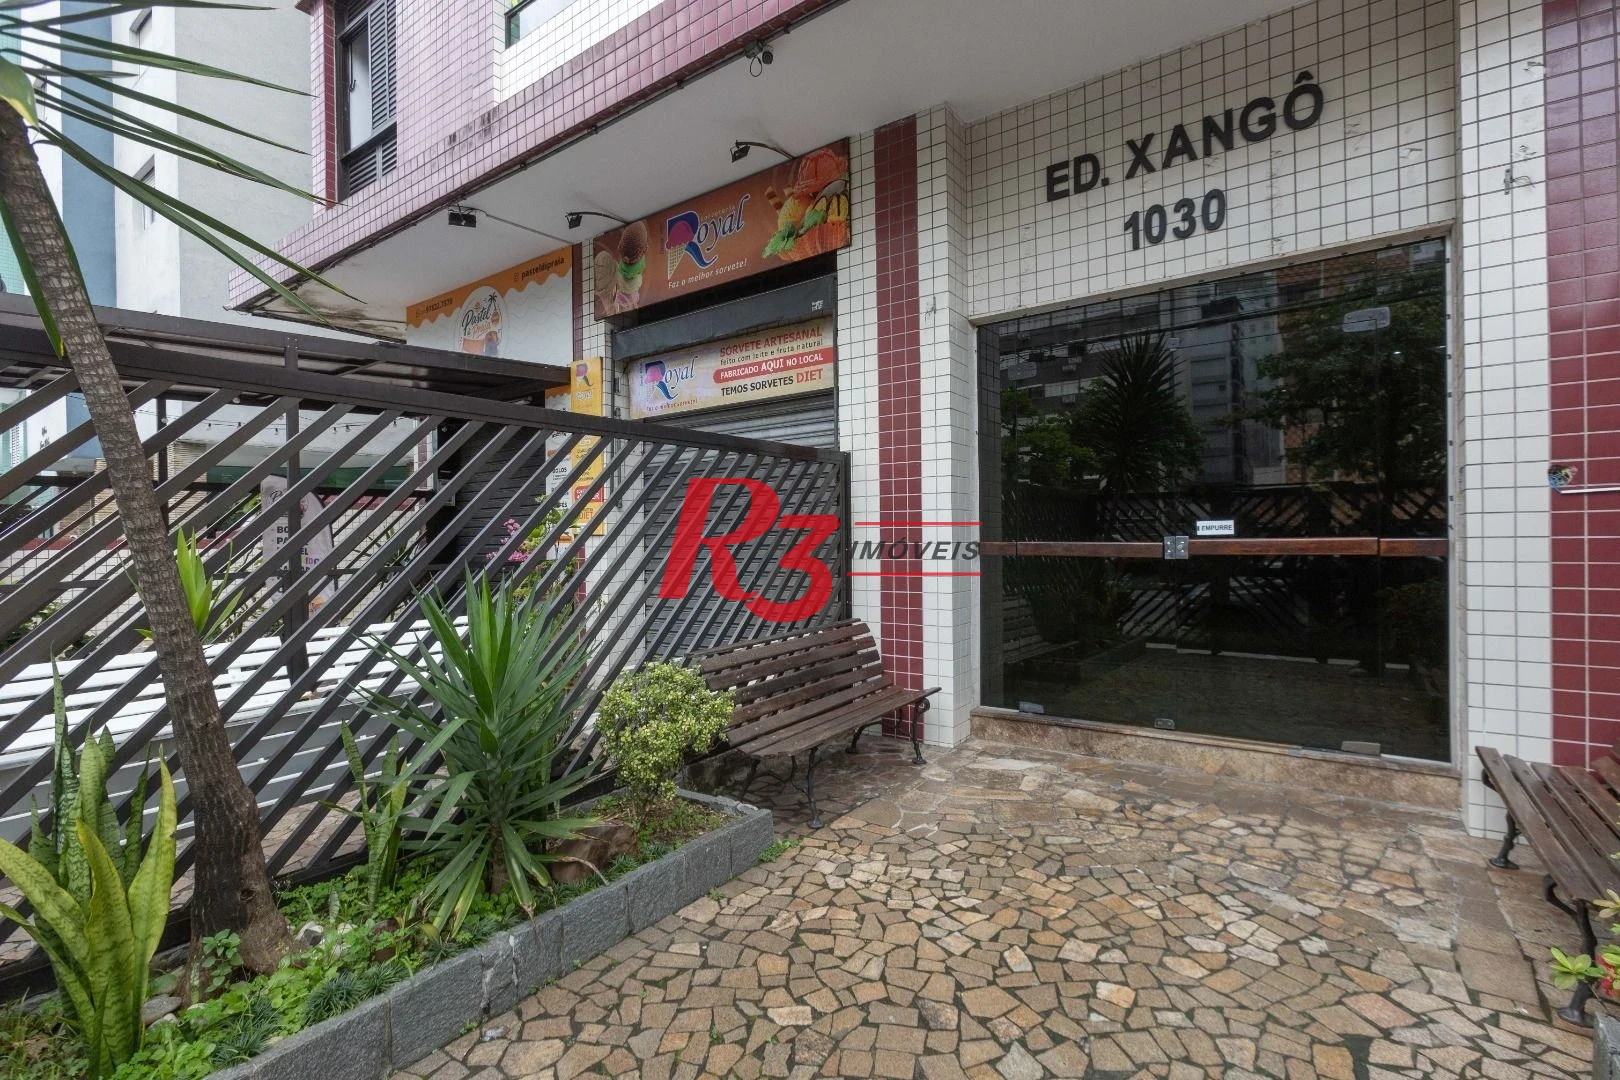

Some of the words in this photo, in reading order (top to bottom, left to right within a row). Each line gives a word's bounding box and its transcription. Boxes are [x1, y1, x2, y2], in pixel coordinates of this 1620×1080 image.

[1046, 153, 1110, 202] ED.
[1125, 70, 1324, 180] XANGÔ
[665, 194, 750, 270] Royal
[1123, 188, 1226, 251] 1030
[687, 270, 713, 284] melhor
[715, 257, 748, 276] sorvete!
[462, 302, 492, 336] Pastel
[720, 340, 761, 358] SORVETE
[763, 327, 823, 348] ARTESANAL
[720, 358, 736, 366] feito
[737, 354, 751, 362] com
[752, 350, 768, 359] leite
[776, 344, 794, 354] fruta
[796, 338, 823, 350] natural
[644, 355, 698, 400] Royal
[720, 365, 759, 380] FABRICADO
[761, 358, 785, 372] AQUI
[786, 358, 797, 367] NO
[799, 353, 824, 365] LOCAL
[721, 384, 749, 397] TEMOS
[750, 375, 794, 392] SORVETES
[796, 368, 824, 384] DIET
